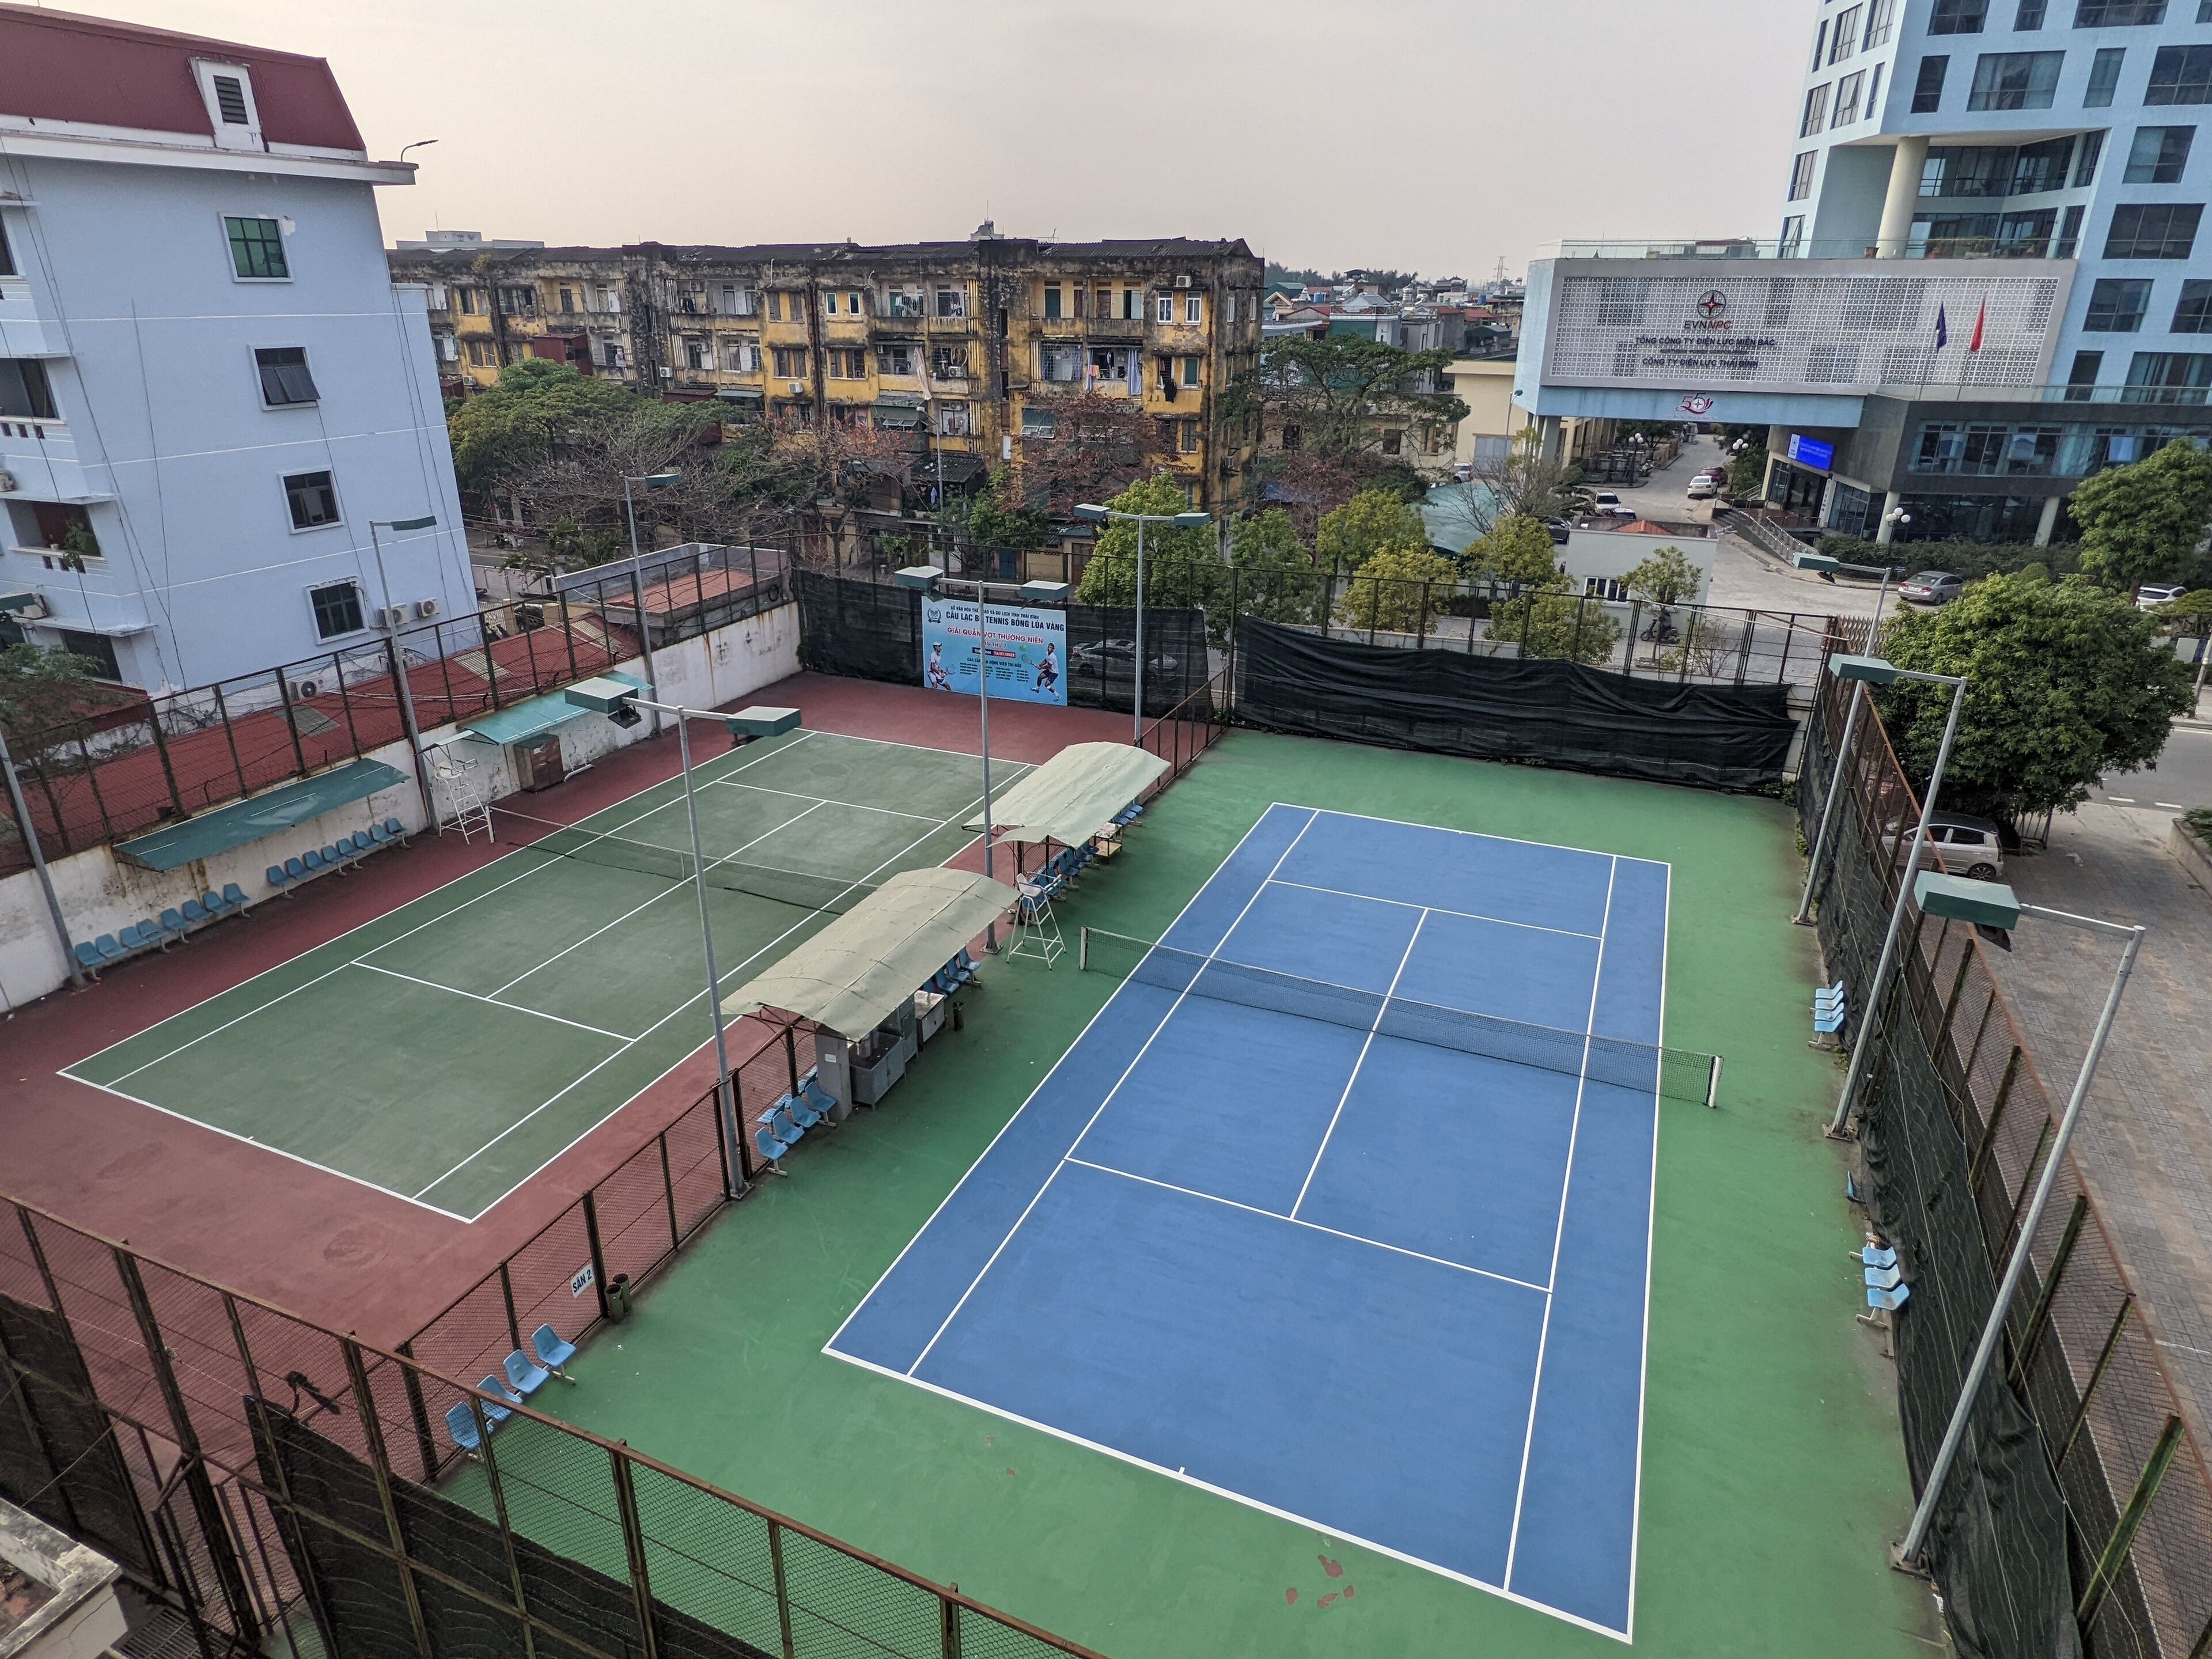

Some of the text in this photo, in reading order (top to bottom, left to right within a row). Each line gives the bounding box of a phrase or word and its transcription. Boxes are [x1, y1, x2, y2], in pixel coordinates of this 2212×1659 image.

[1684, 320, 1731, 329] EVNNPC
[1635, 335, 1657, 344] TỔNG
[1658, 336, 1681, 344] CÔNG
[1719, 359, 1737, 368] THÁI
[946, 611, 959, 619] CÂU
[961, 613, 972, 622] LẠC
[986, 616, 1009, 626] TENNIS
[1011, 618, 1029, 628] BÔNG
[1031, 620, 1044, 630] LÚA
[1046, 621, 1065, 632] VÀNG
[1028, 635, 1043, 644] NIÊN
[573, 1269, 592, 1293] SÂN 2
